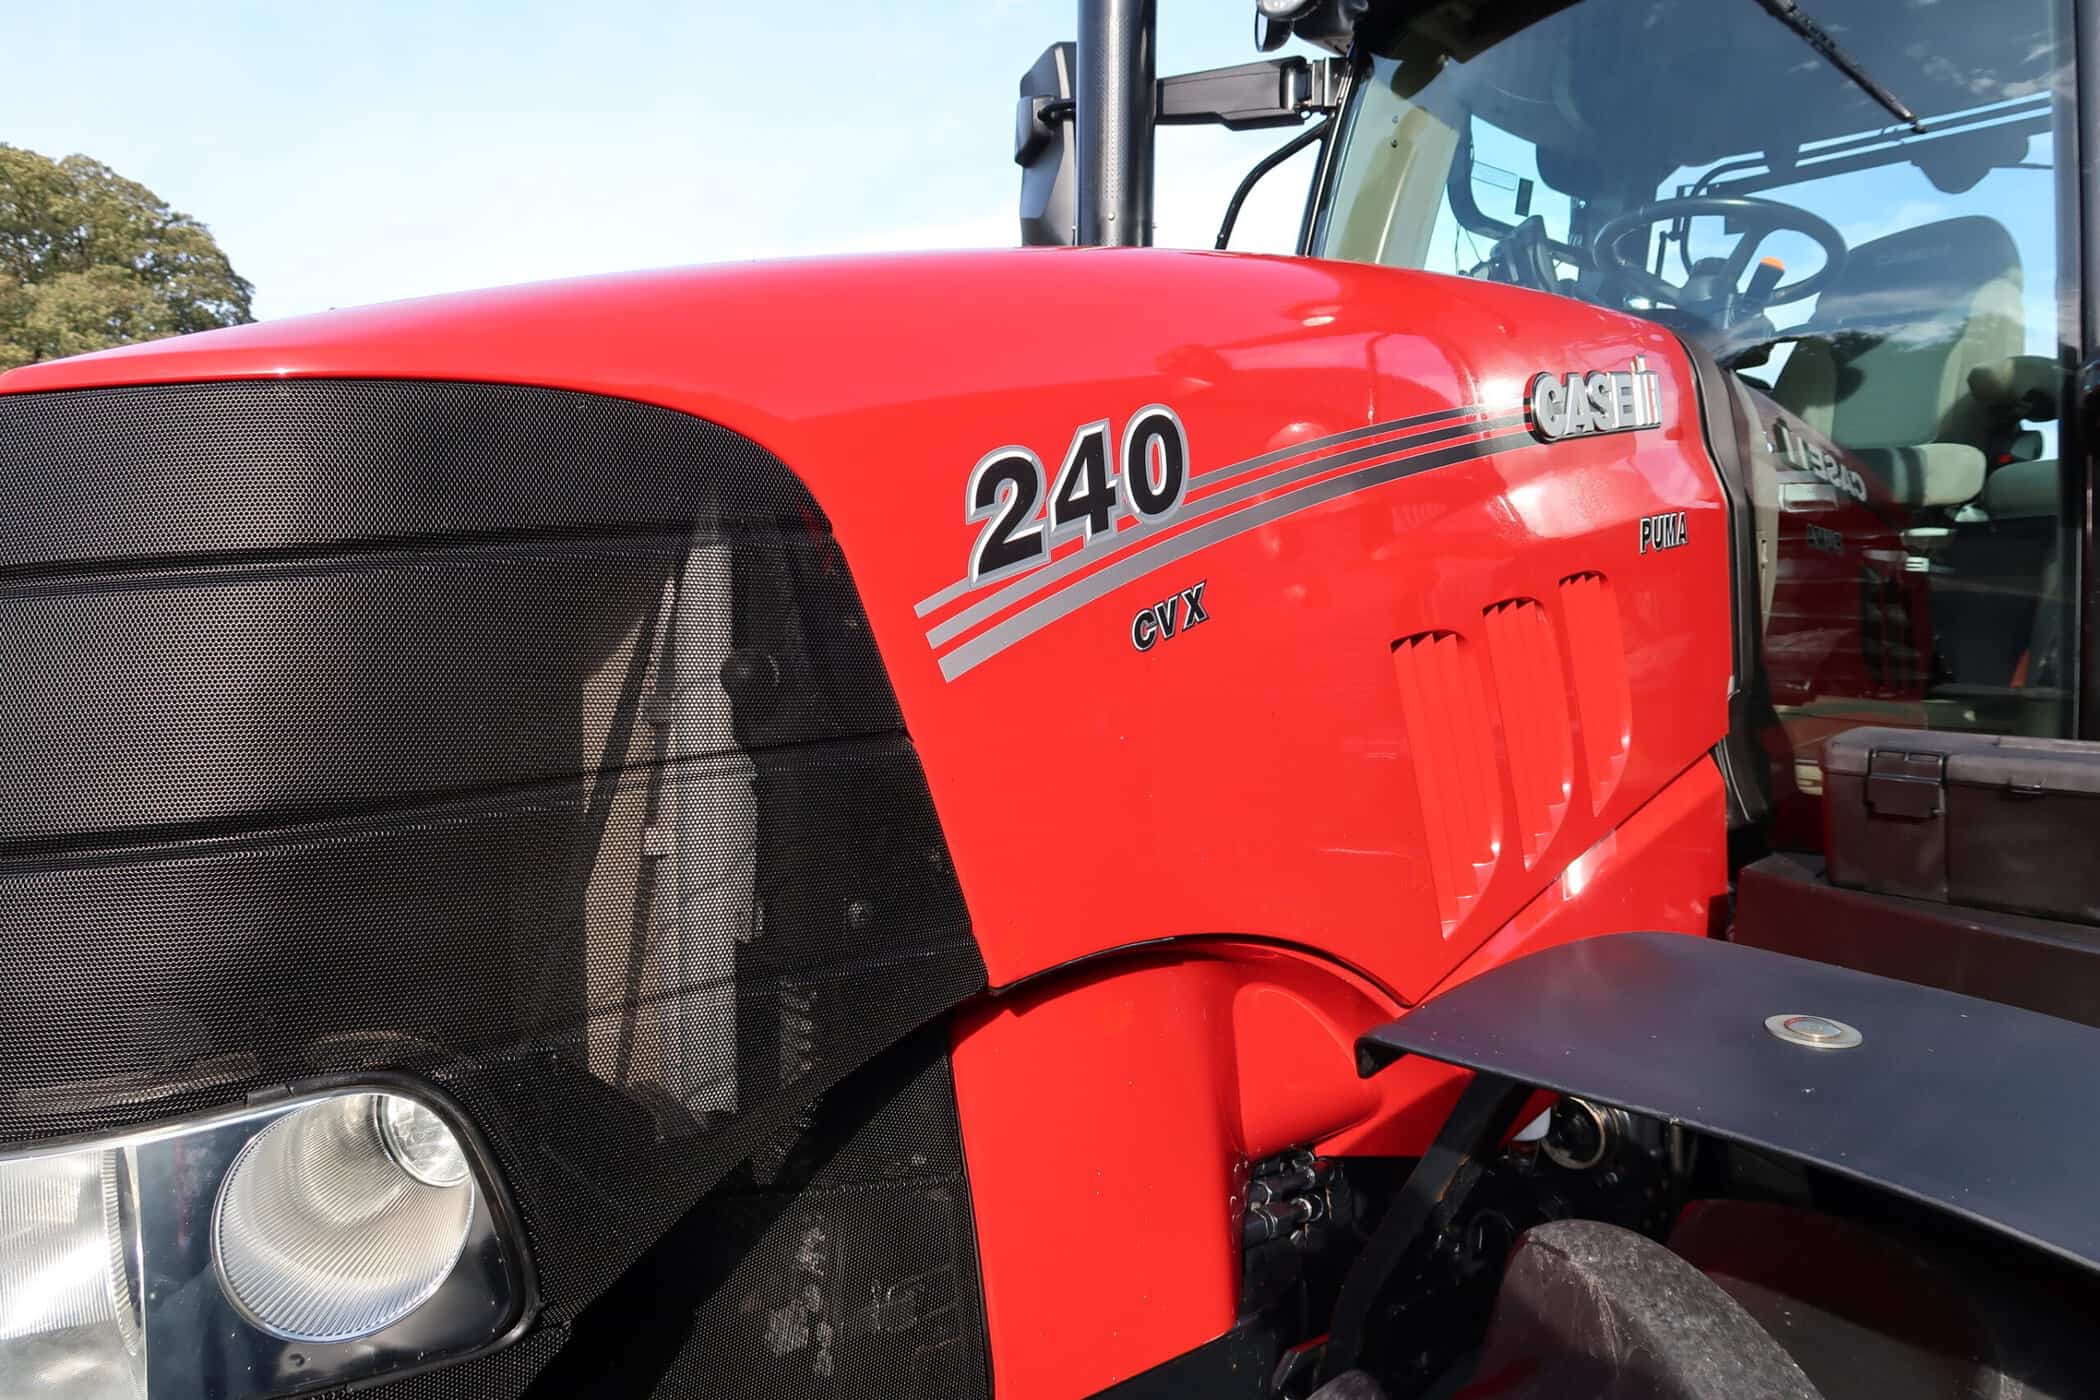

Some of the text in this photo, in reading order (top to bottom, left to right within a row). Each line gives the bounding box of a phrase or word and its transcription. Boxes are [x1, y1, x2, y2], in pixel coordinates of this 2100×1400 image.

[966, 403, 1189, 590] 240
[1639, 511, 1688, 554] PUMA
[1131, 580, 1209, 652] CVX
